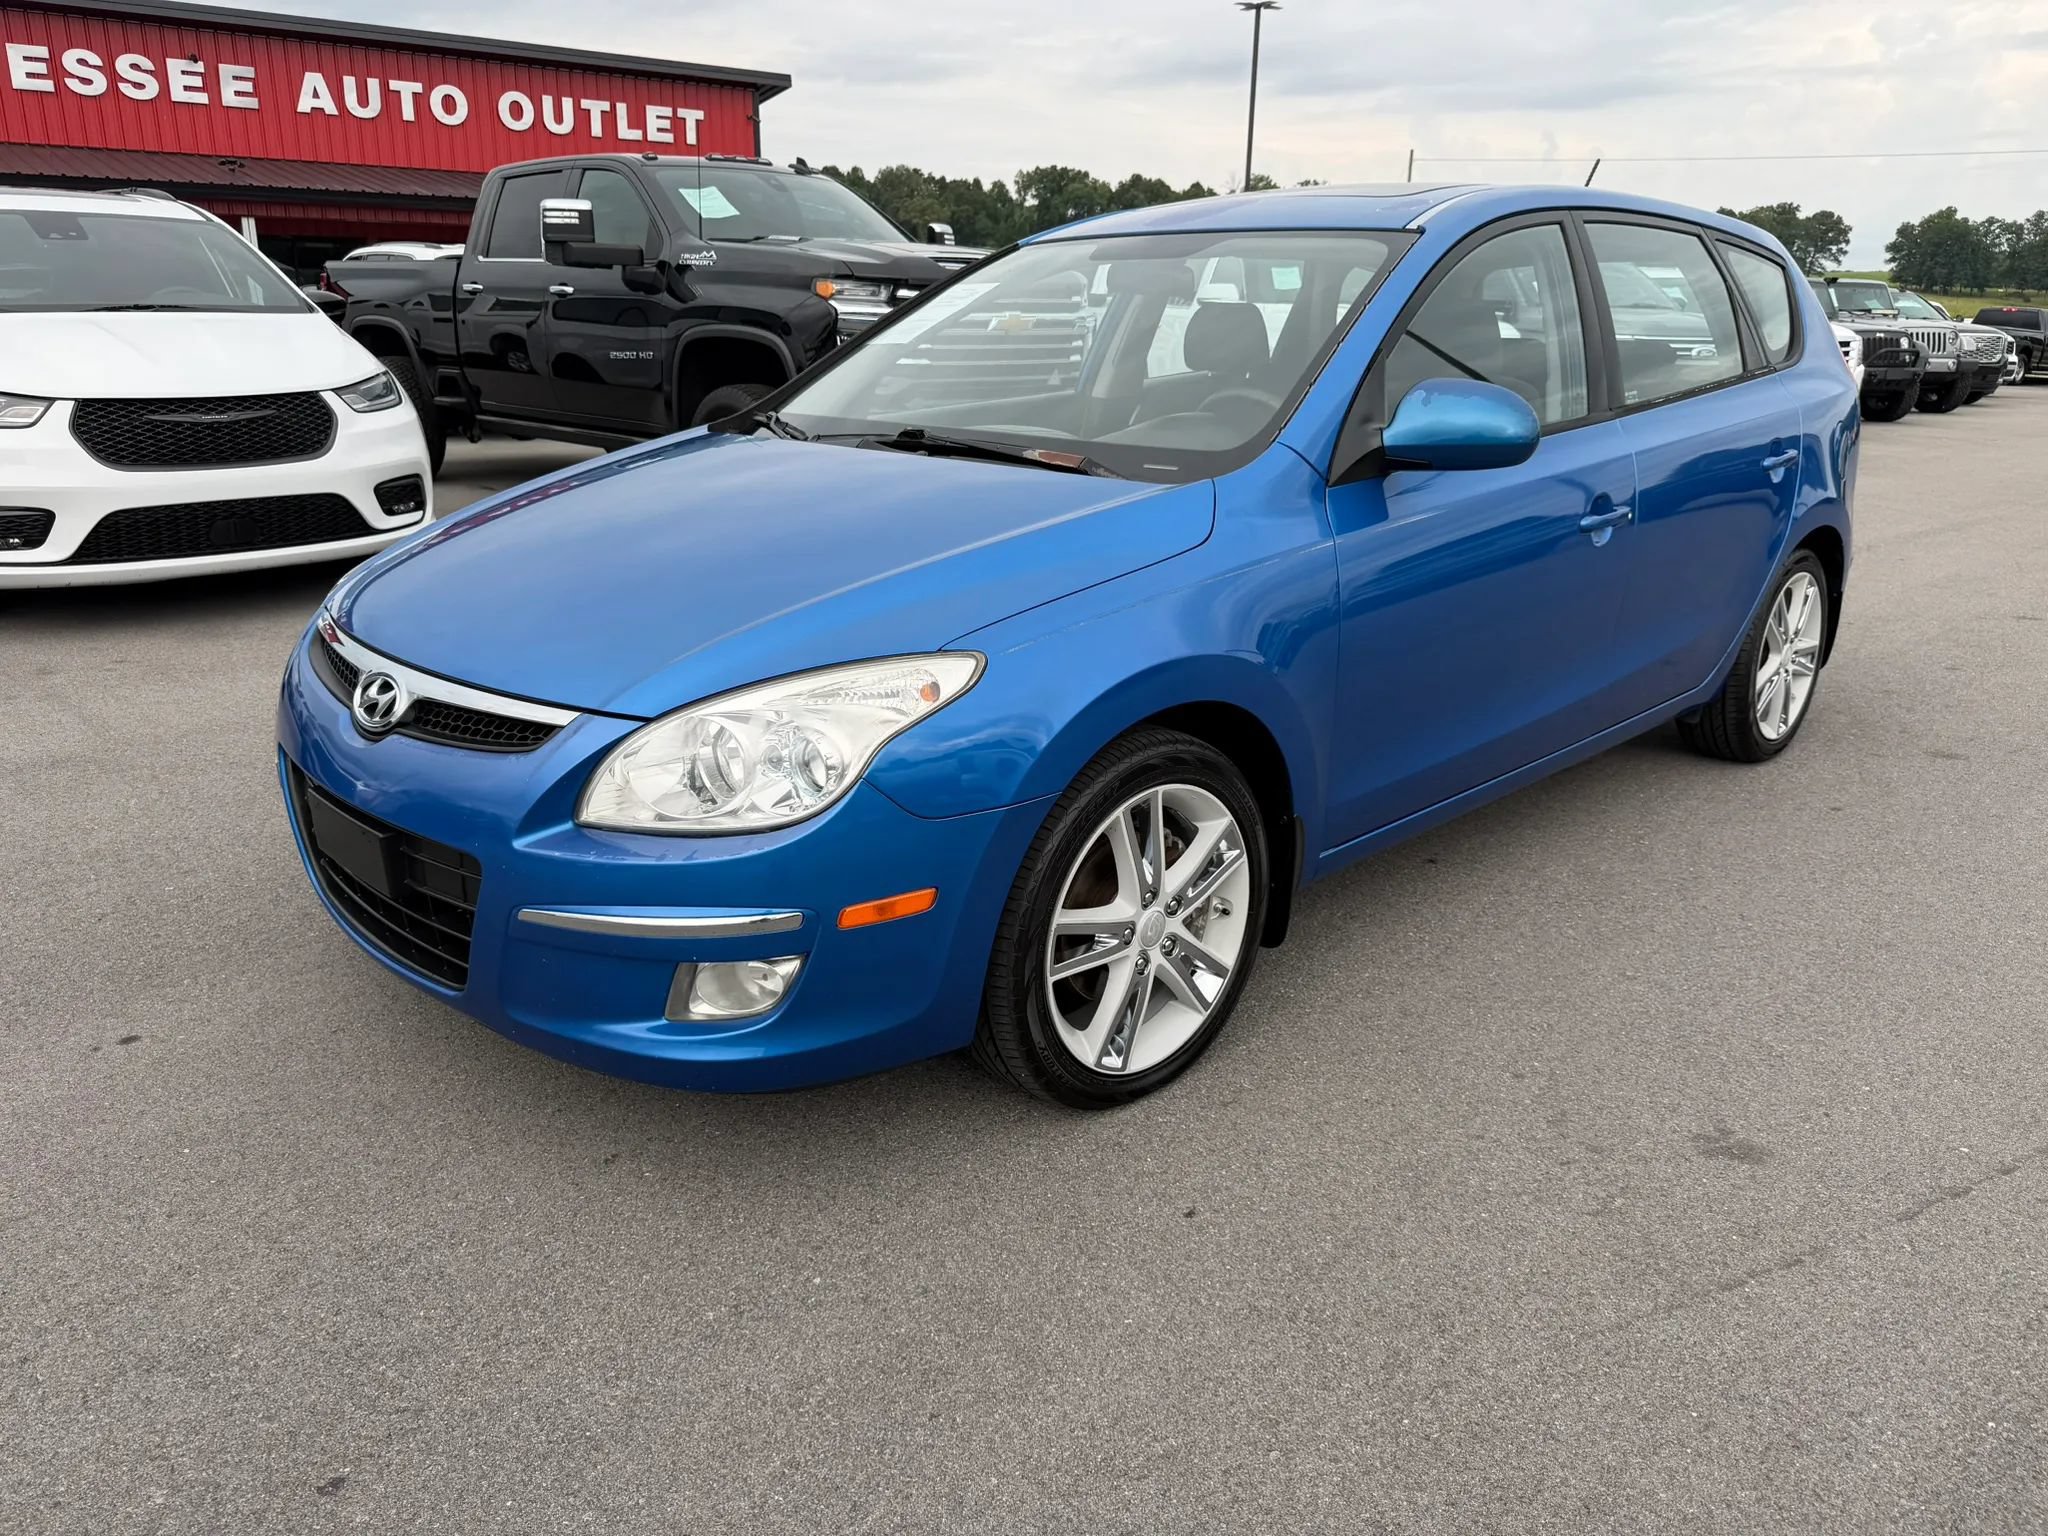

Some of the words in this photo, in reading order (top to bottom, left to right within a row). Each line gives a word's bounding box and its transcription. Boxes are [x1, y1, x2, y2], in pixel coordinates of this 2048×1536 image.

[4, 42, 259, 109] ESSEE
[296, 71, 469, 126] AUTO
[497, 90, 705, 145] OUTLET
[609, 351, 637, 360] 2500
[639, 351, 654, 360] HD
